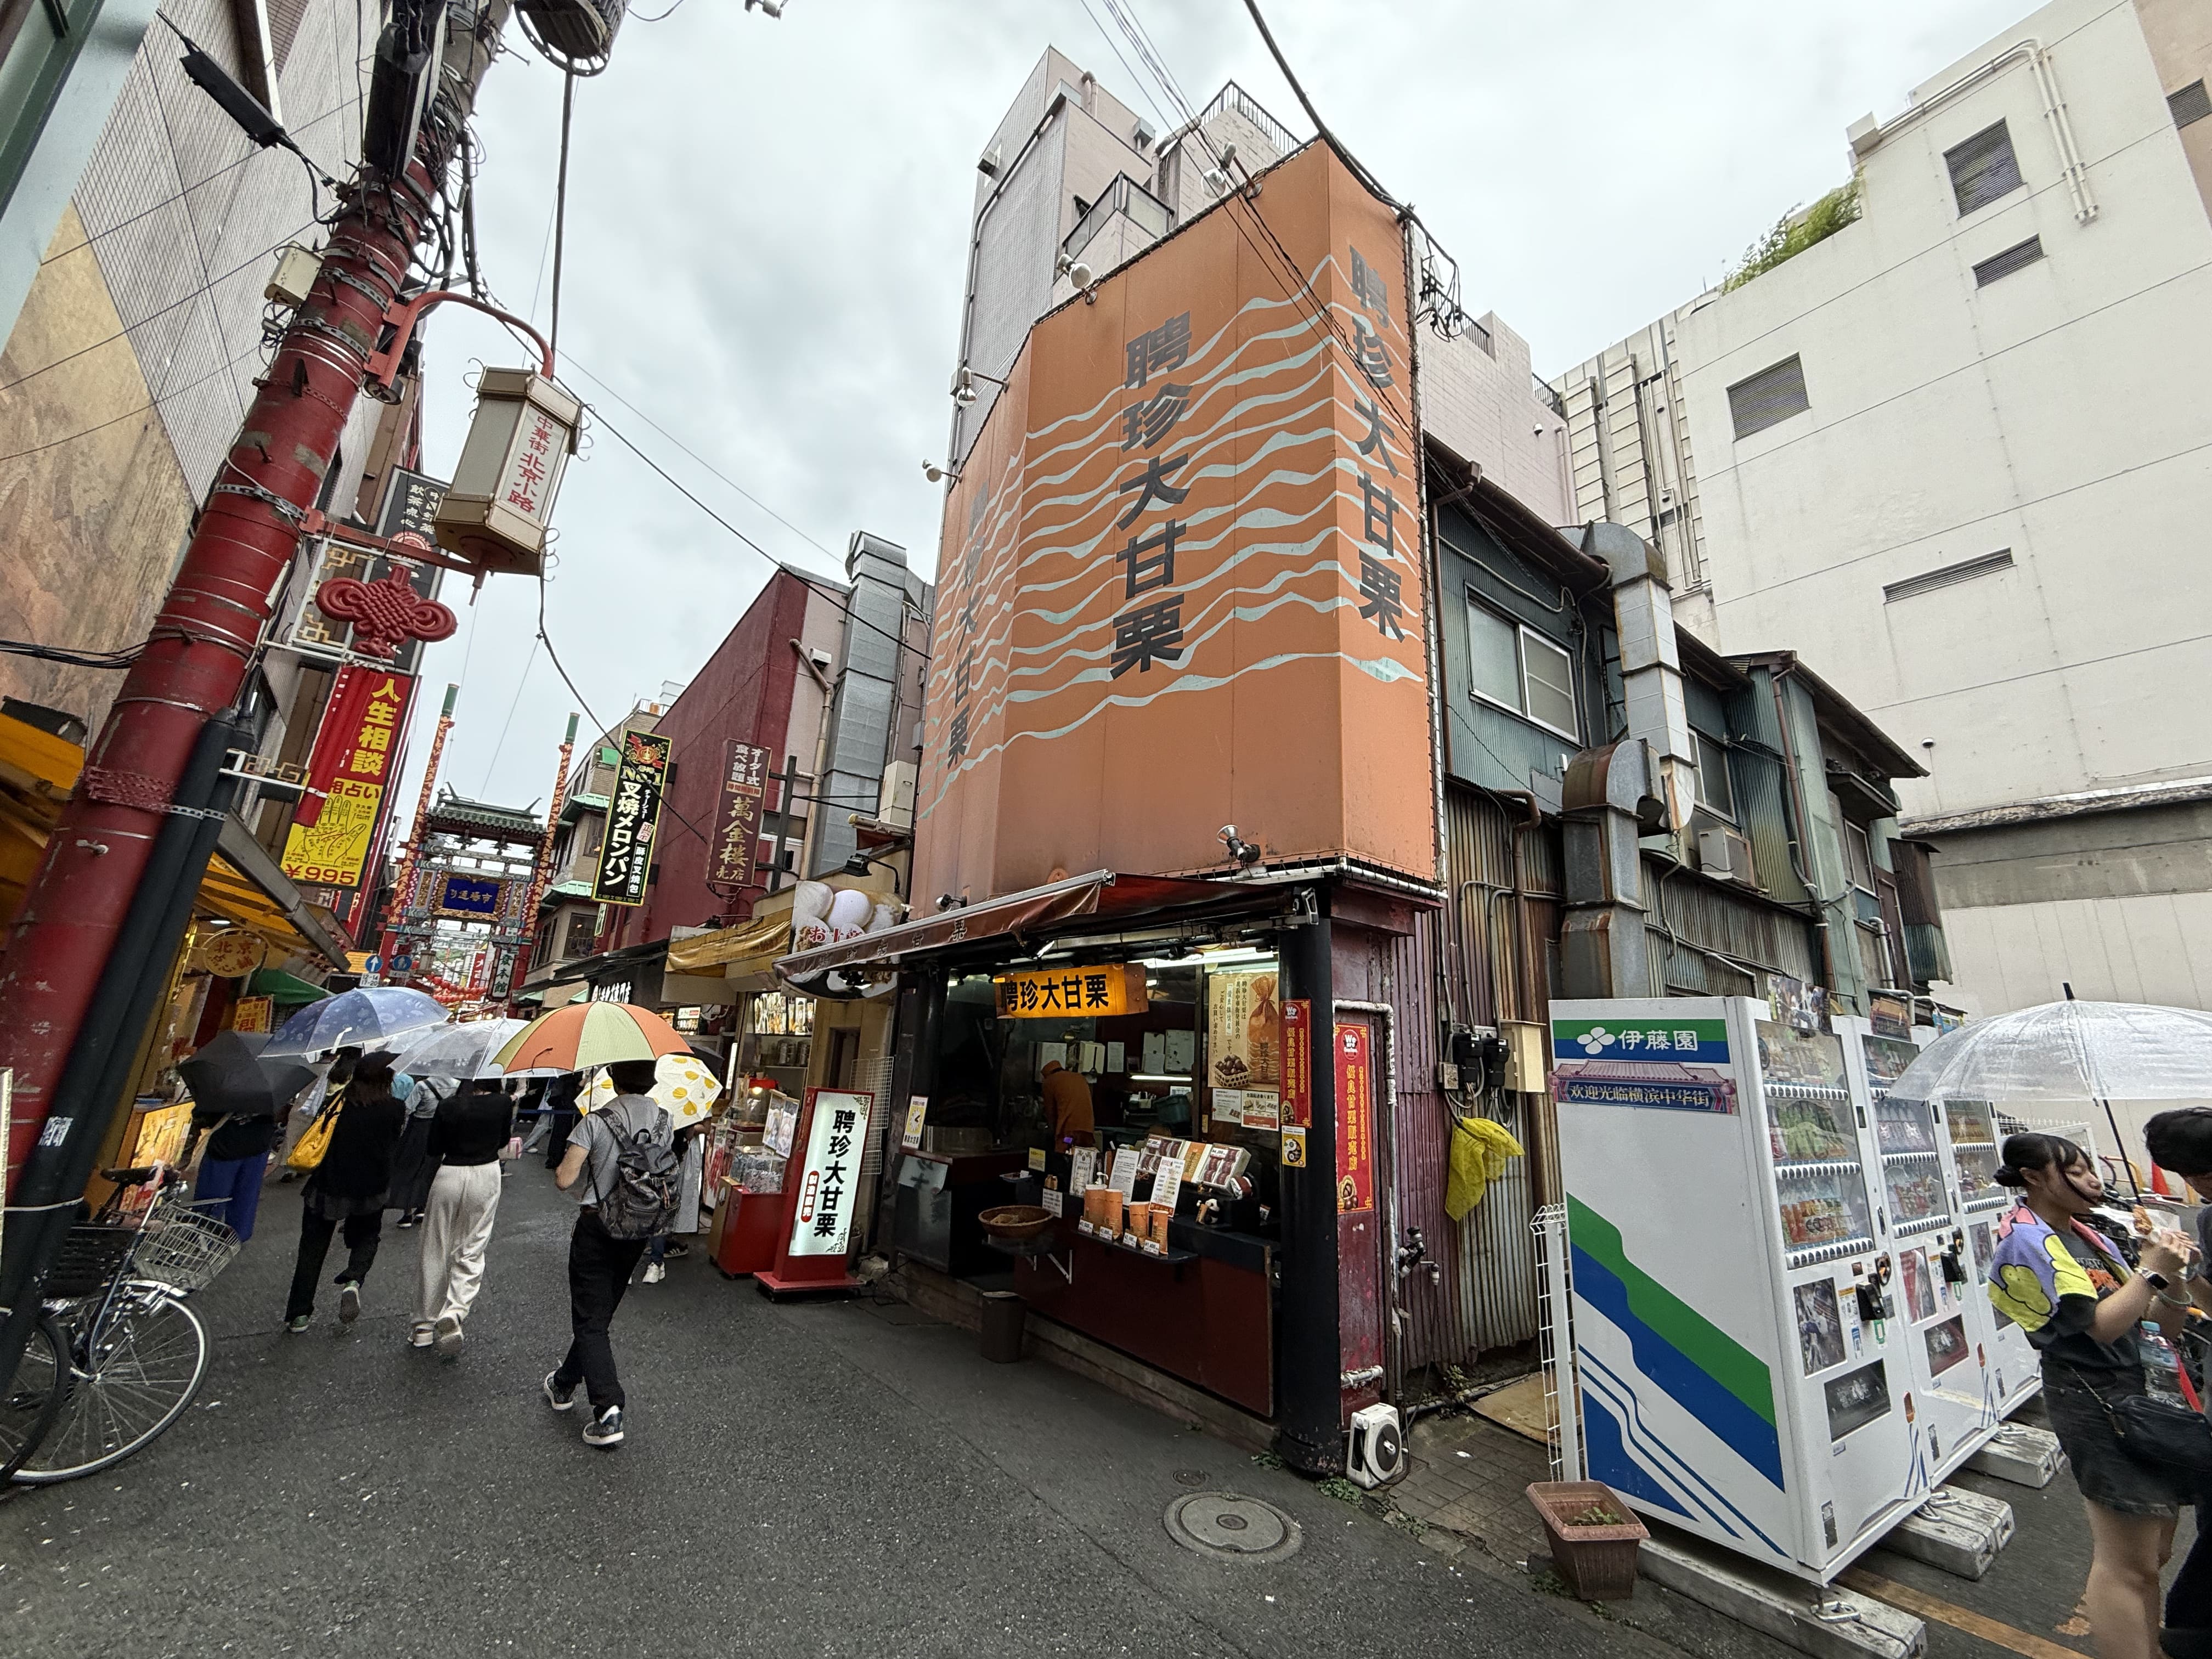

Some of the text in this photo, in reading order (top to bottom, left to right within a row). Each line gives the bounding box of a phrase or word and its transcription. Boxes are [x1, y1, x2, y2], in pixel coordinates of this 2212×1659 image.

[1349, 244, 1406, 644] 聘珍大甘栗
[507, 414, 554, 515] 中華街北京小路
[1110, 311, 1192, 681] 聘珍大甘栗
[350, 678, 402, 776] 人生相談
[620, 765, 662, 786] No.1
[731, 744, 749, 783] 食べ放題
[746, 748, 764, 786] オーダー式
[604, 781, 642, 886] 叉焼メロンパン
[285, 864, 357, 885] ¥995
[1001, 974, 1109, 1012] 聘珍大甘栗
[1344, 1034, 1357, 1043] We
[1618, 1029, 1699, 1052] 伊藤園
[1570, 1084, 1709, 1107] 欢迎光临横滨中华街
[814, 1109, 856, 1238] 聘珍大甘栗
